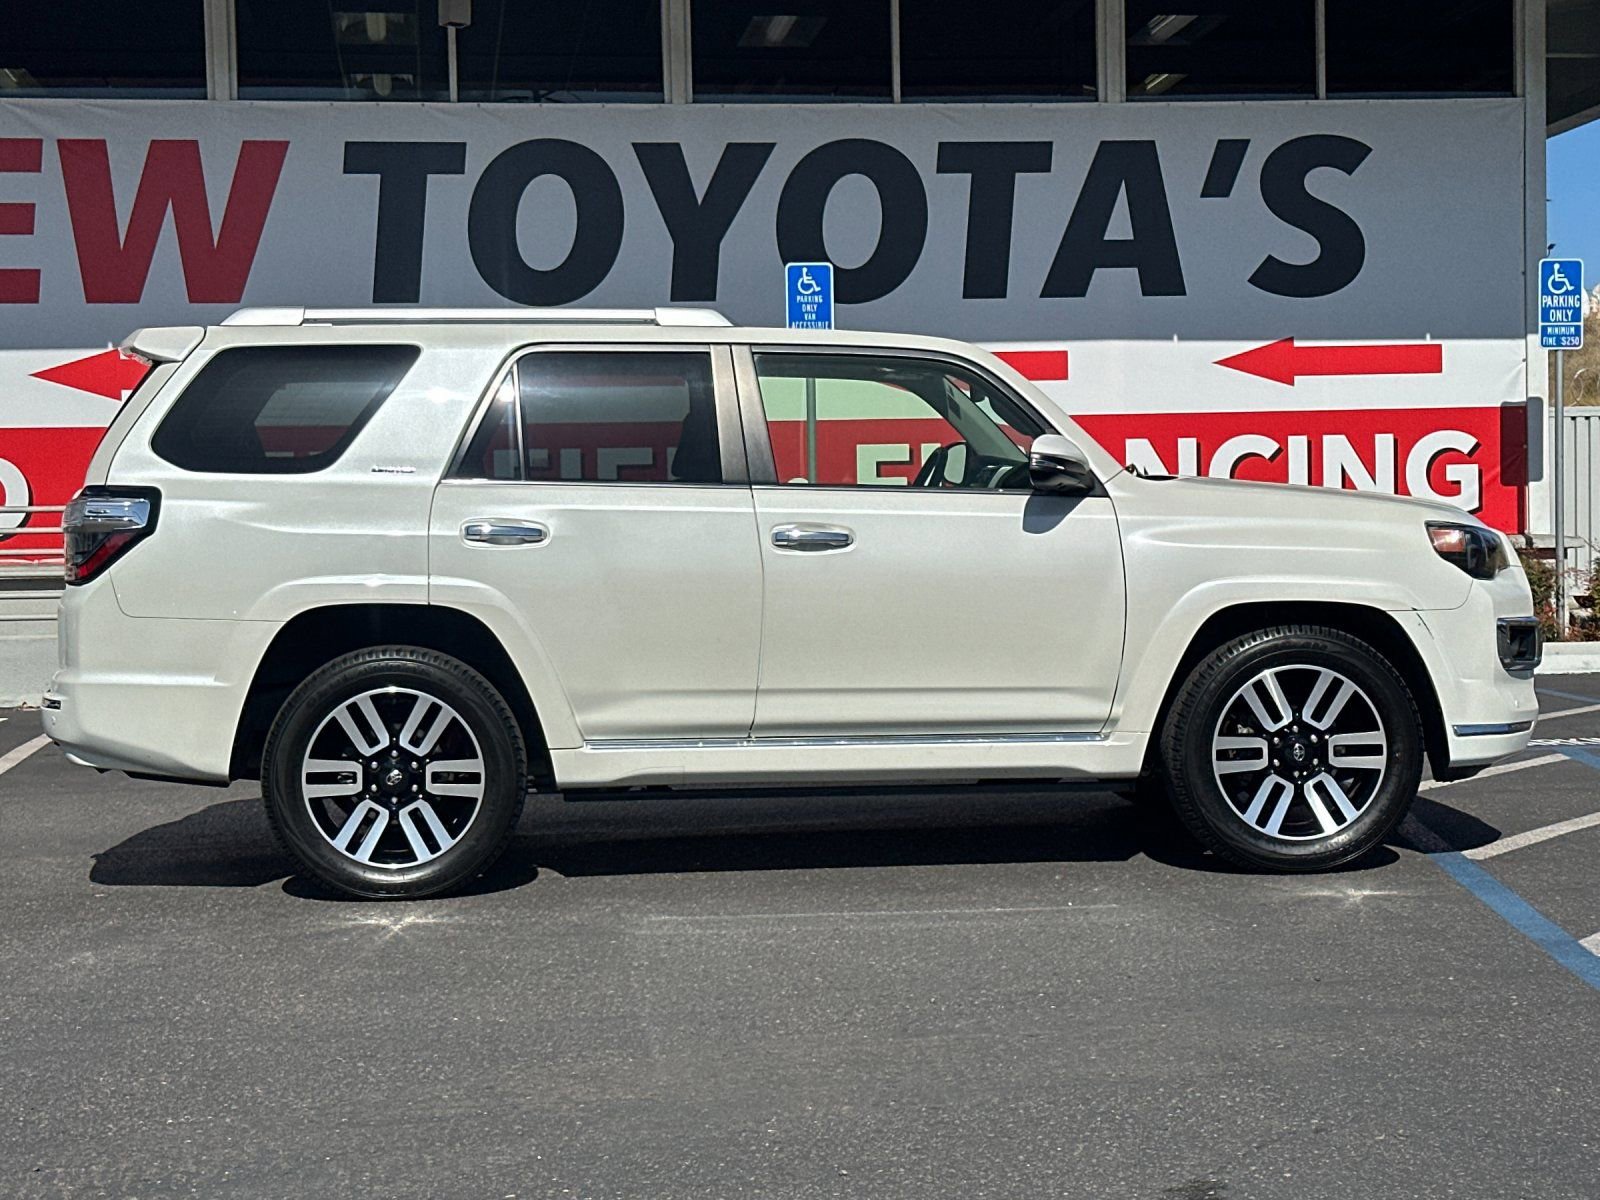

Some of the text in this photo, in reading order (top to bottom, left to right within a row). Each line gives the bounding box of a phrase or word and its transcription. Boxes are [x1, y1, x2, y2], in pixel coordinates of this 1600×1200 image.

[343, 134, 1373, 306] TOYOTA'S
[797, 295, 823, 303] PARKING
[1542, 295, 1580, 308] PARKING
[802, 304, 817, 312] ONLY
[1550, 309, 1573, 322] ONLY
[1547, 326, 1575, 335] MINIMUM
[1543, 336, 1557, 346] FINE
